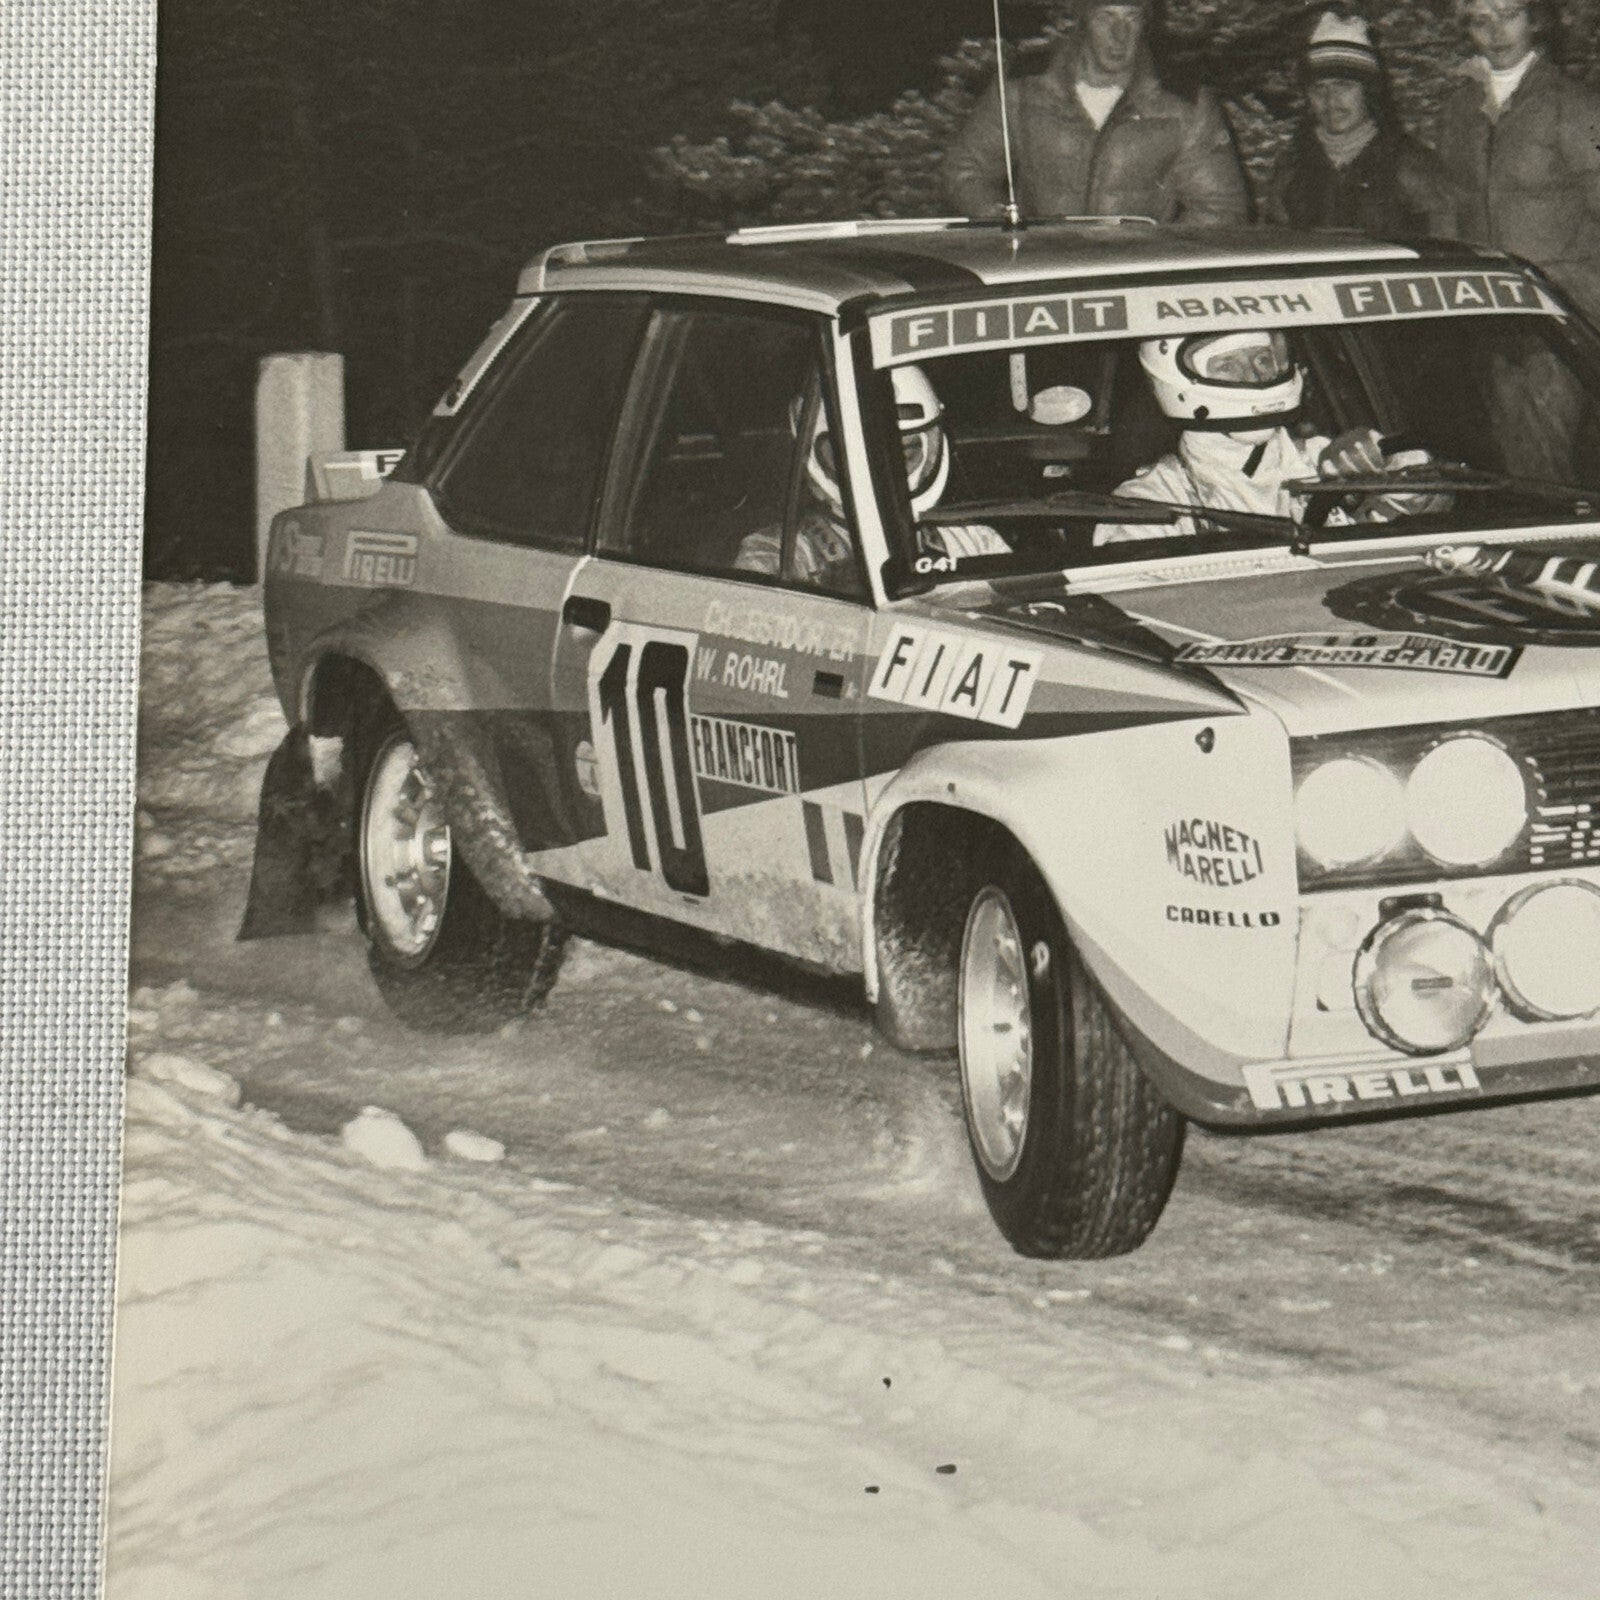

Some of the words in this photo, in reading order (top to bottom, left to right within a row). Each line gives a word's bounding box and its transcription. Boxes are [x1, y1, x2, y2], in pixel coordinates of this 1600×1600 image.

[908, 302, 1115, 347] FIAT
[1156, 293, 1313, 320] ABARTH
[1349, 279, 1525, 313] FIAT
[881, 636, 1031, 714] FIAT
[598, 640, 710, 897] 10
[690, 716, 798, 794] FRANCFORT
[1164, 818, 1263, 866] MAGNETI
[1165, 904, 1281, 928] CARELLO
[1242, 1046, 1482, 1110] PIRELLI
